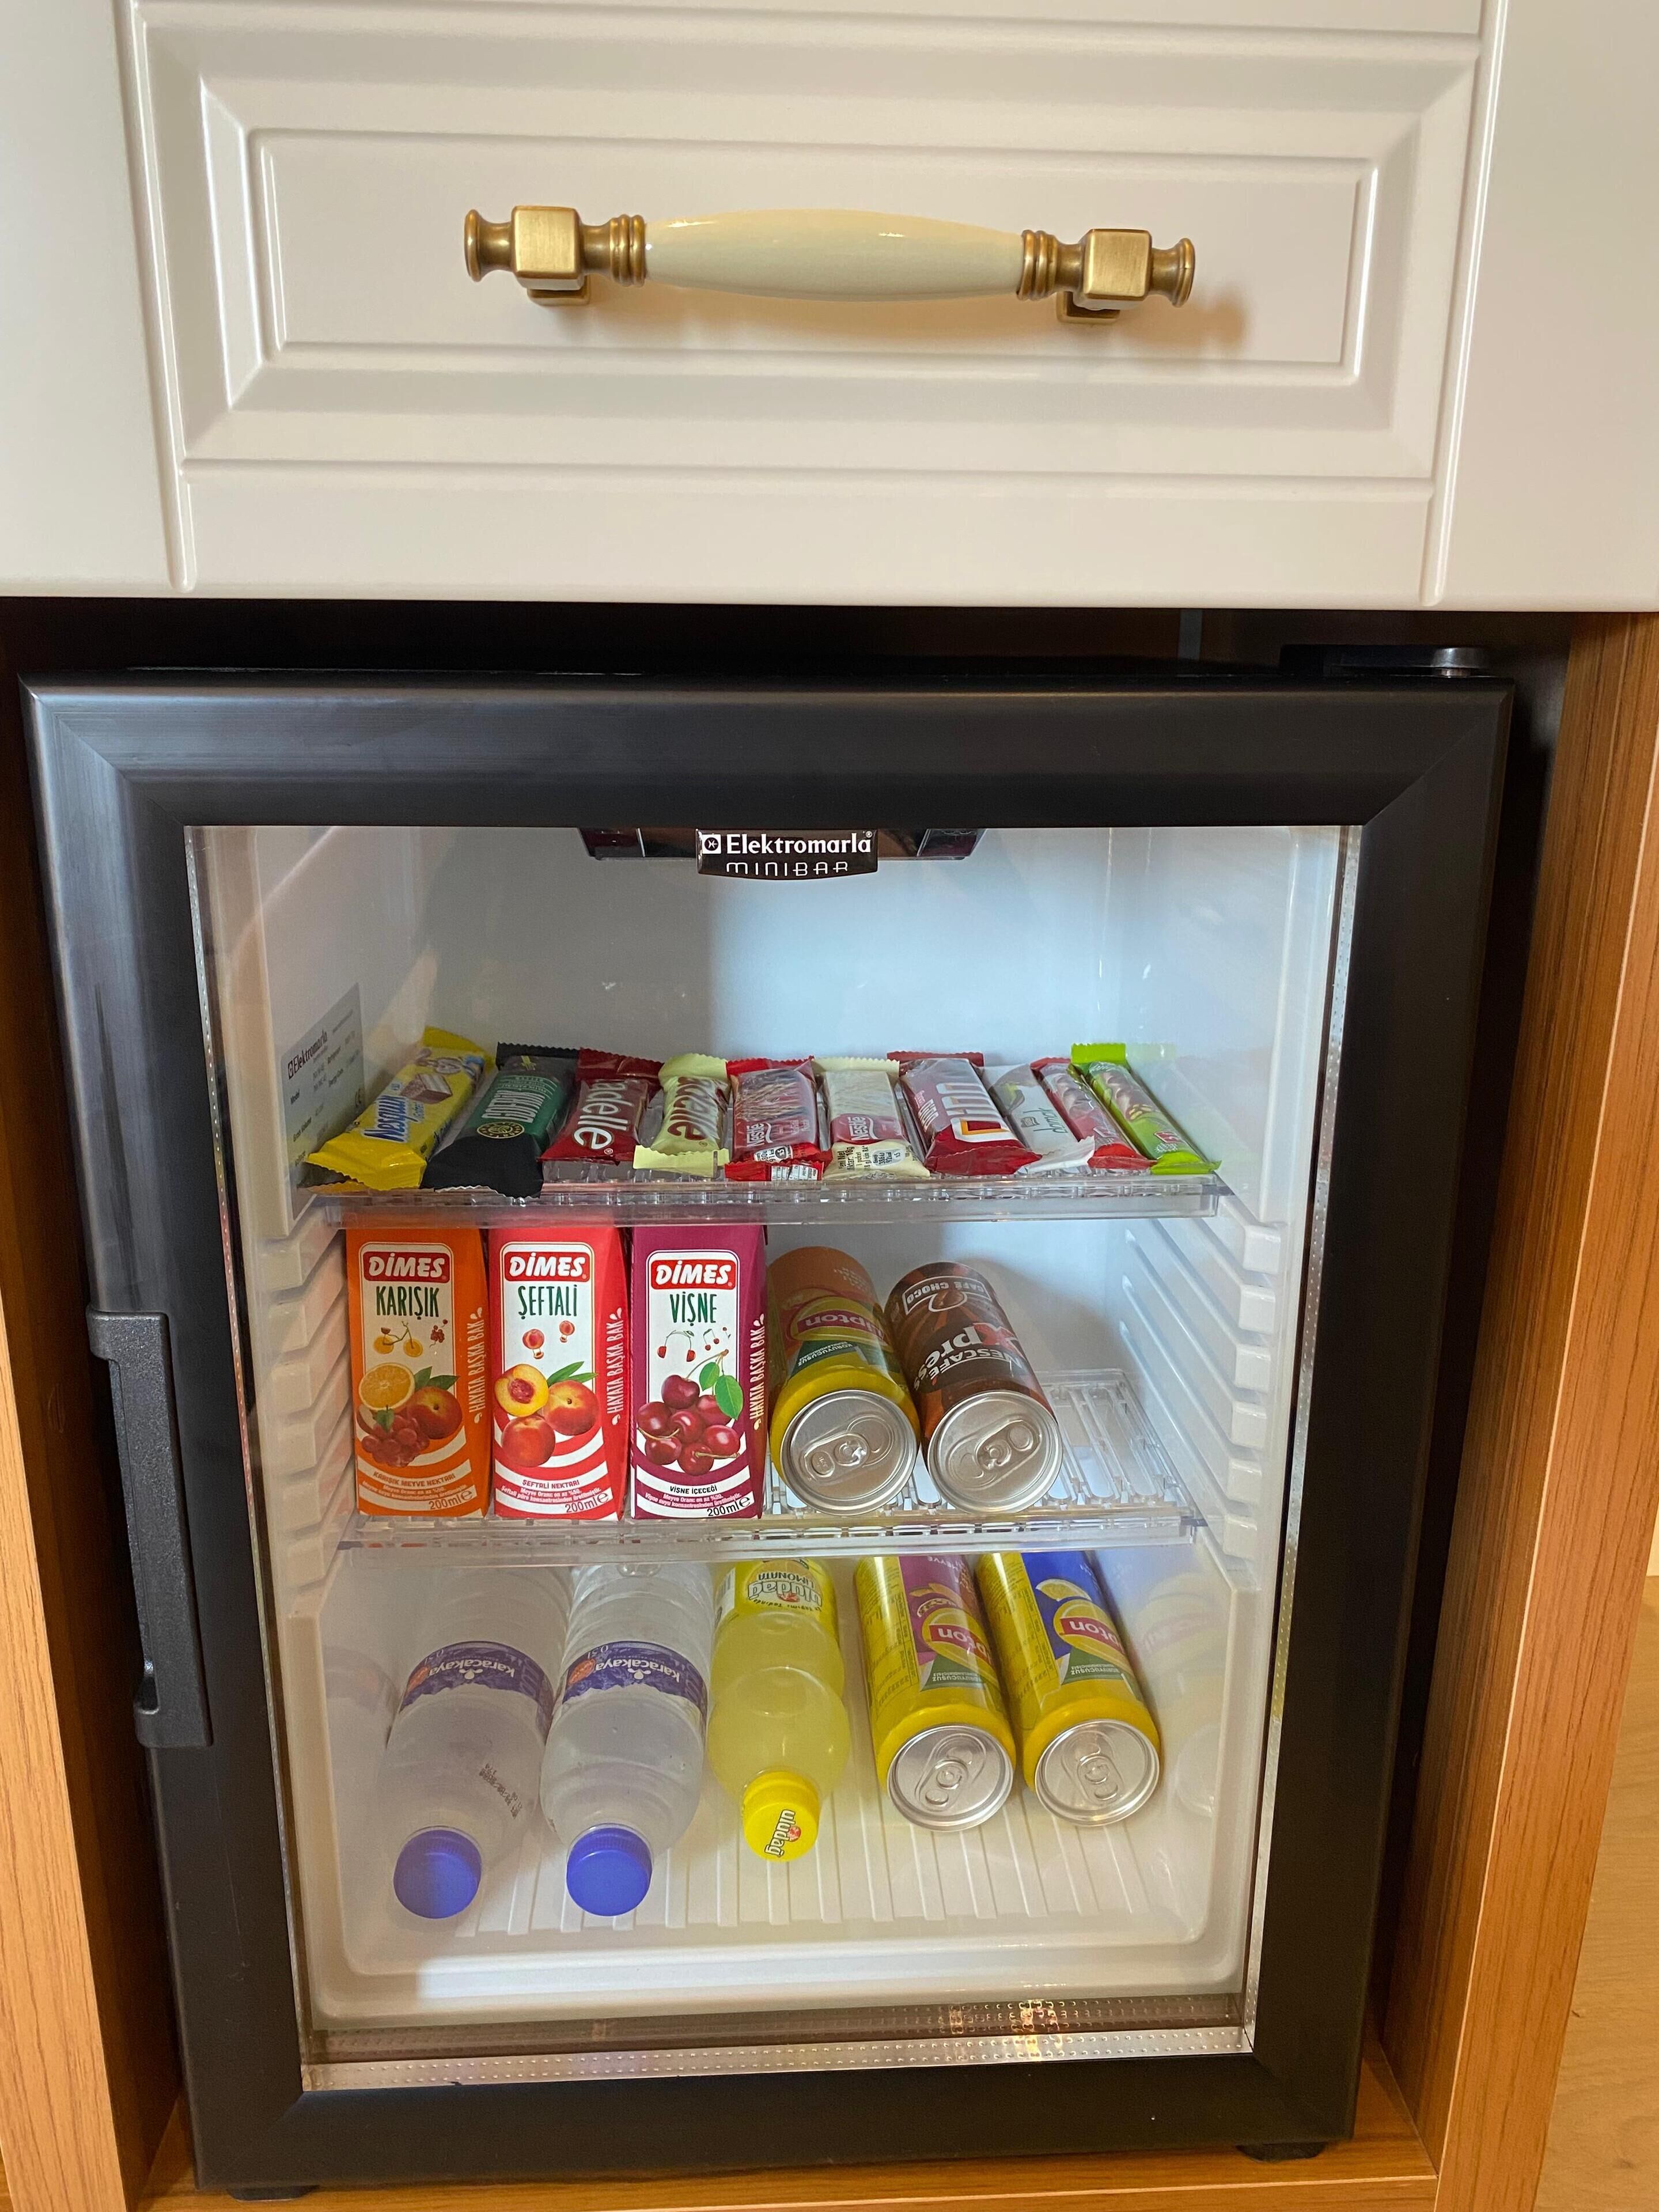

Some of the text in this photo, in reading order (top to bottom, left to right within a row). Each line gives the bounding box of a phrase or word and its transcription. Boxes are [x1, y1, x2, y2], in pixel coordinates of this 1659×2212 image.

[726, 833, 871, 854] Elektromarla
[726, 862, 848, 876] MINIBAR
[574, 1078, 632, 1150] adelle
[847, 1116, 870, 1141] Nestlé
[369, 1252, 445, 1278] DİMES
[510, 1252, 586, 1278] DİMES
[655, 1259, 732, 1285] DİMES
[376, 1286, 440, 1319] KARIŞIK
[518, 1285, 577, 1319] ŞEFTALİ
[907, 1281, 984, 1304] CAFÉ CHOCO
[670, 1291, 717, 1325] VİŞNE
[805, 1313, 882, 1338] Lipton
[467, 1319, 485, 1413] HAYATA BAŞKA BAK
[607, 1319, 623, 1414] HAYATA BAŞKA BAK
[798, 1343, 854, 1366] KORUYUCUSUZ
[929, 1348, 1013, 1386] NESCAFÉ
[749, 1325, 765, 1420] HAYATA BAŞKA BAK
[427, 1474, 456, 1486] NEKTARI
[520, 1488, 537, 1497] Meyve
[522, 1479, 579, 1489] ŞEFTALİ NEKTARI
[692, 1484, 718, 1495] İÇECEĞİ
[429, 1494, 460, 1510] 200ml
[565, 1498, 597, 1513] 200ml
[663, 1493, 680, 1502] Meyve
[707, 1502, 739, 1516] 200ml
[748, 1581, 823, 1608] uludağ
[429, 1659, 516, 1678] karacakaya
[595, 1658, 680, 1683] karacakaya
[764, 1809, 796, 1855] uludağ
